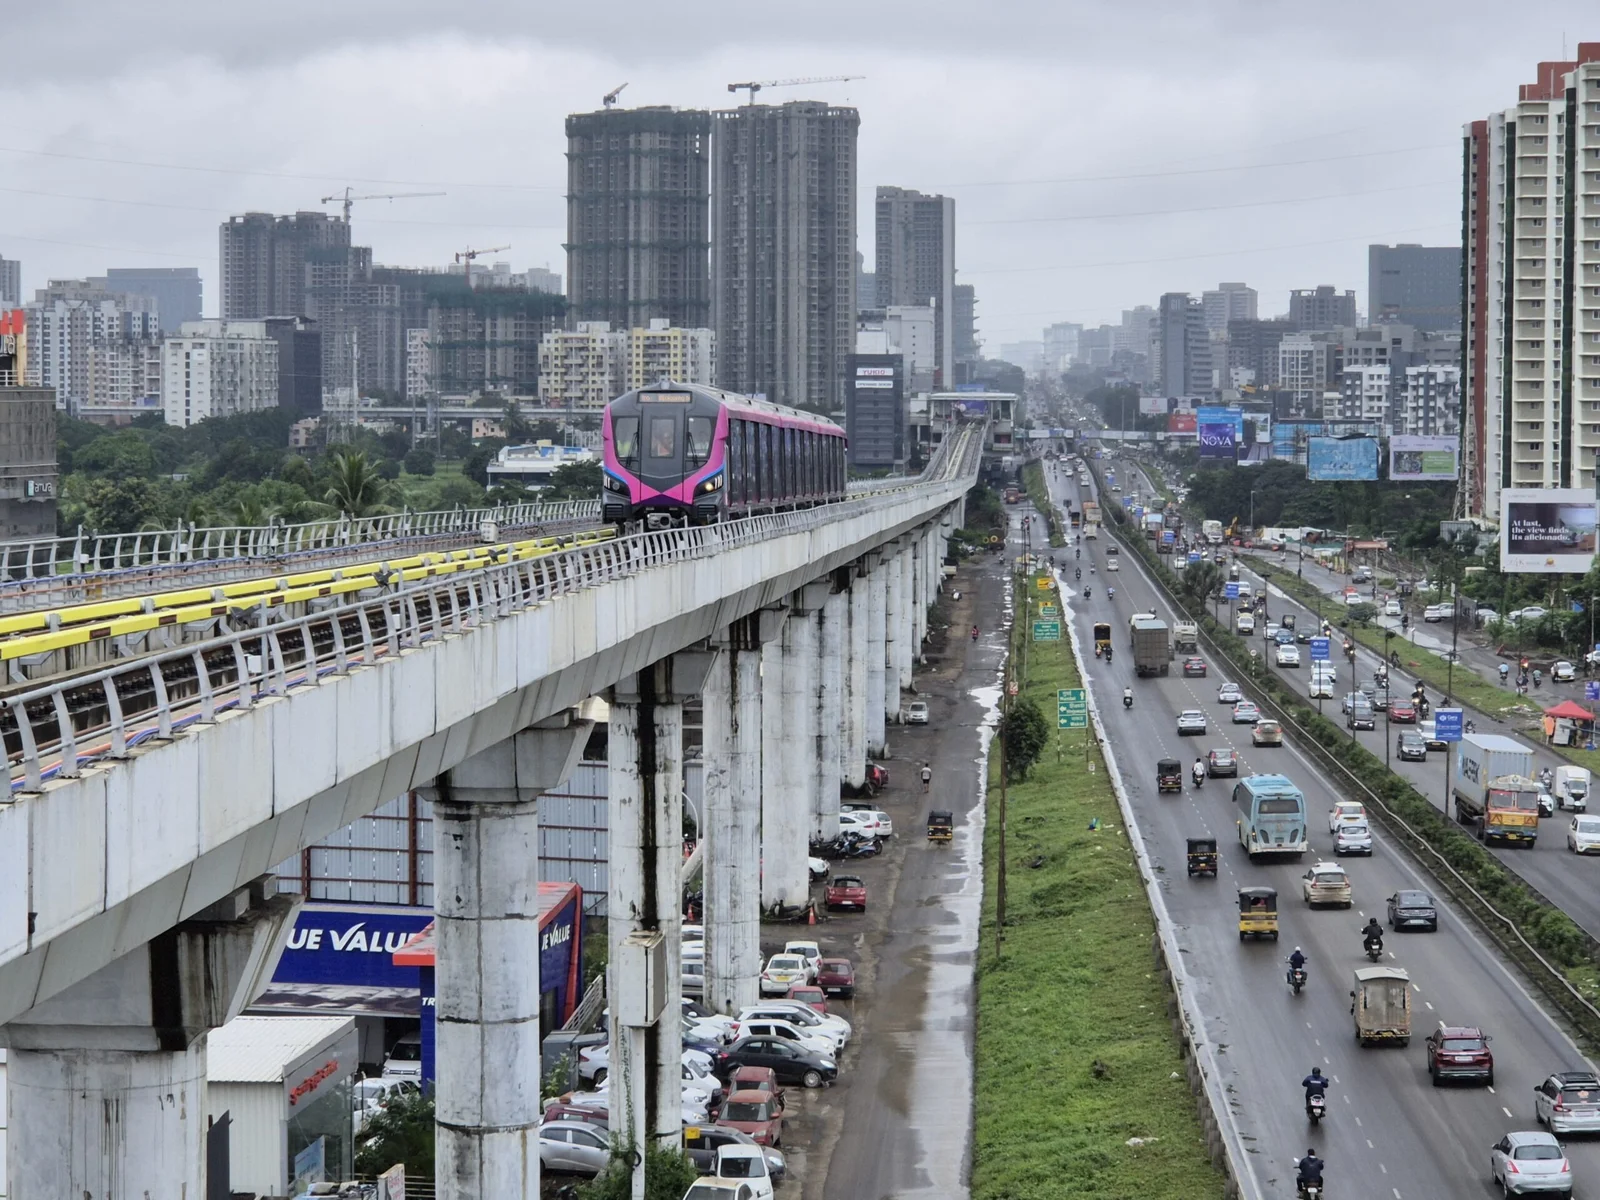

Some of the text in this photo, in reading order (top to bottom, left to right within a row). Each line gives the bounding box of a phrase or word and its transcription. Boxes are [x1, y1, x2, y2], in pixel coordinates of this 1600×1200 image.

[1201, 436, 1232, 446] NOVA
[1511, 519, 1542, 528] At last,
[1511, 533, 1523, 541] its
[549, 923, 571, 947] VALUE
